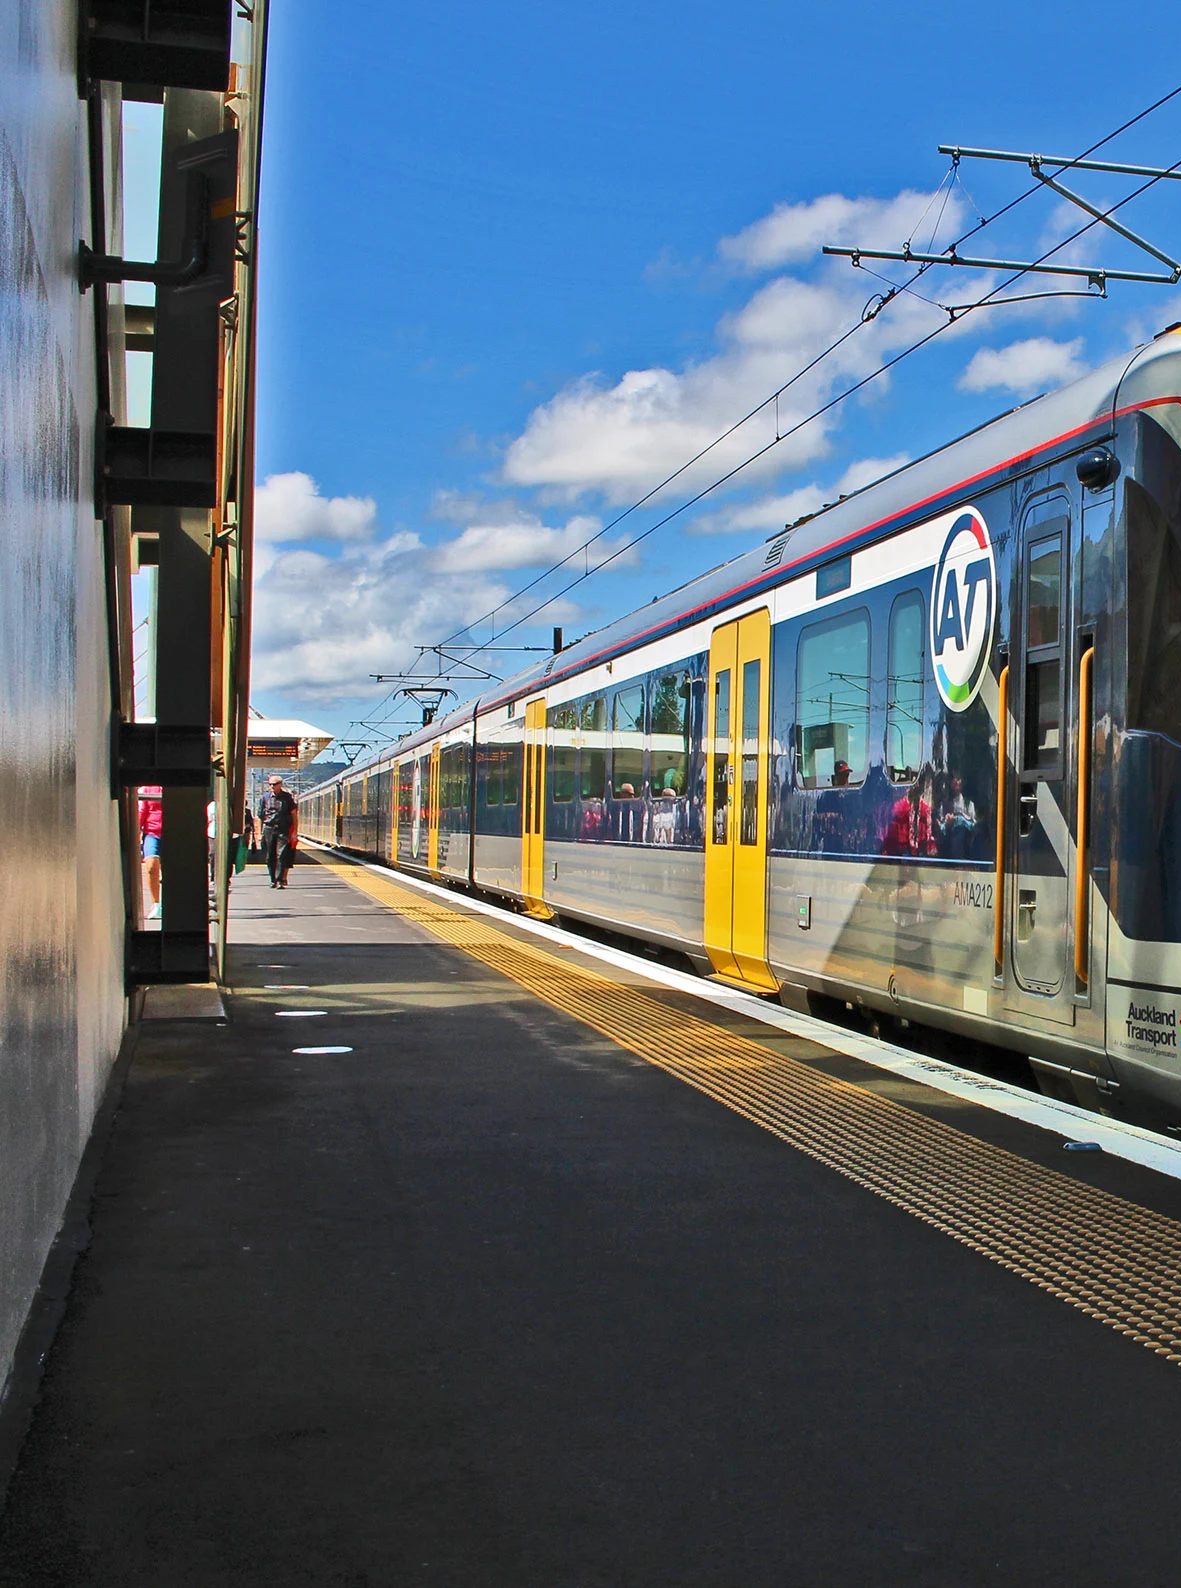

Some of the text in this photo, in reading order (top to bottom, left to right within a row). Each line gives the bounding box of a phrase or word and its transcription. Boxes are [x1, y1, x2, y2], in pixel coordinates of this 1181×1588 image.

[934, 556, 991, 657] AT
[953, 881, 993, 909] AMA212
[1127, 1002, 1176, 1027] Auckland
[1125, 1020, 1177, 1046] Transport
